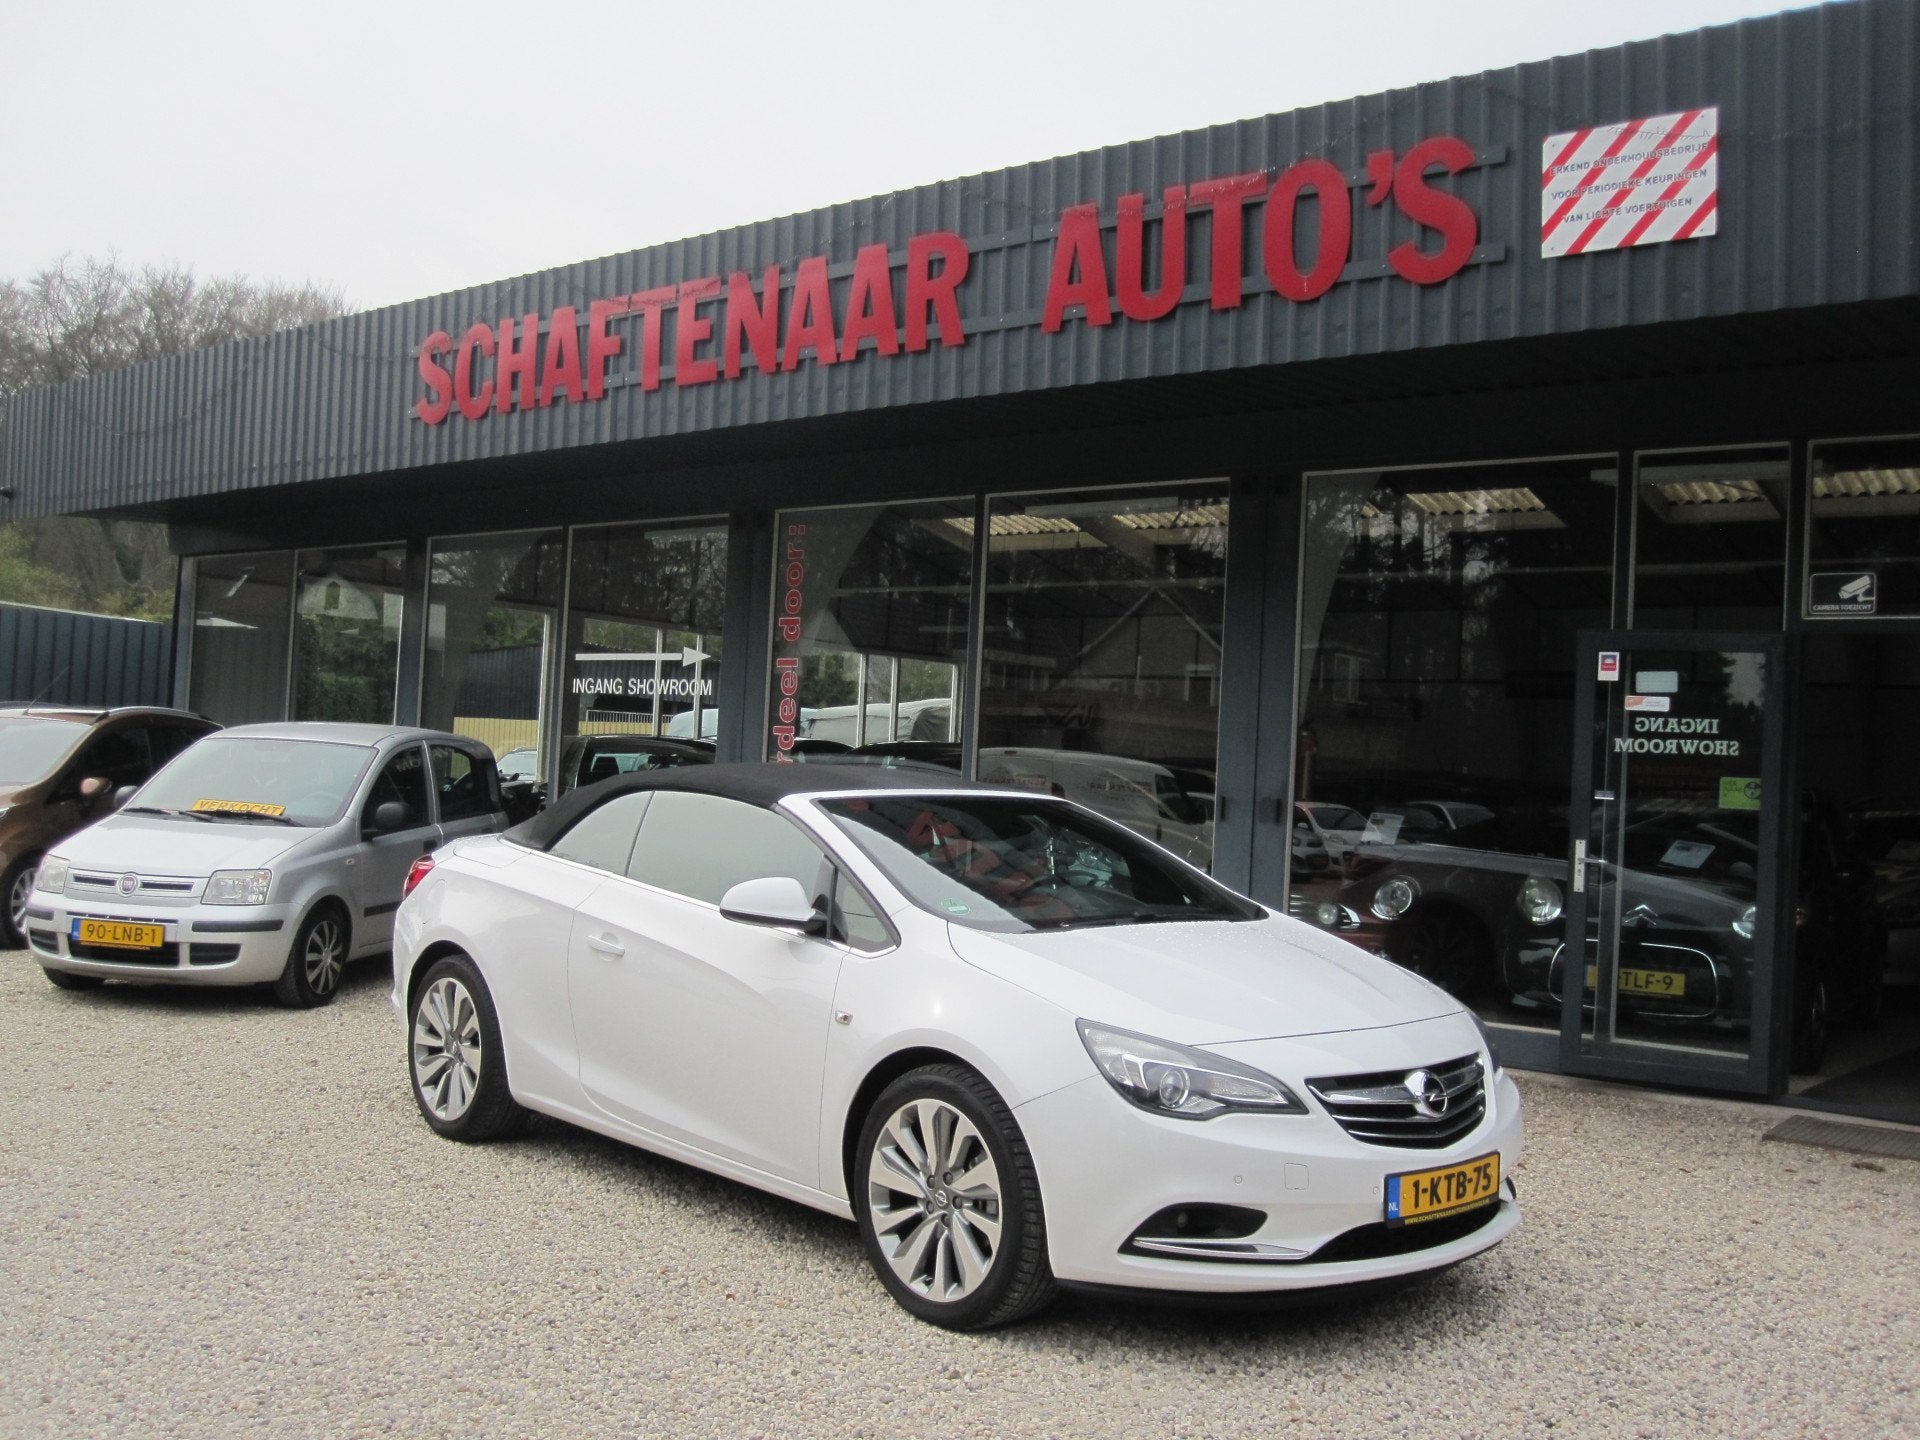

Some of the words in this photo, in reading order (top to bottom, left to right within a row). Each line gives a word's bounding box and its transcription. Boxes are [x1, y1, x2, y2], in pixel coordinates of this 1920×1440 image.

[1549, 160, 1590, 176] ERKEND
[1593, 142, 1707, 169] ONDERHOUDSBEDRIJF
[1551, 188, 1578, 201] VOOR
[1580, 179, 1642, 196] PERIODIEKE
[1644, 168, 1708, 186] KEURINGEN
[1564, 214, 1584, 224] VAN
[1586, 206, 1623, 220] LICHTE
[1625, 197, 1692, 215] VOERTUIGEN
[417, 230, 970, 426] SCHAFTENAAR
[1040, 134, 1478, 334] AUTO'S
[1812, 604, 1839, 612] CAMERA
[572, 677, 623, 695] INGANG
[627, 678, 713, 696] SHOWROOM
[199, 800, 282, 815] VERKOCHT
[86, 923, 157, 943] 90-LNB-1
[1622, 971, 1674, 992] TLF-9
[1412, 1162, 1492, 1210] 1-KTB-75
[1388, 1202, 1399, 1212] NL
